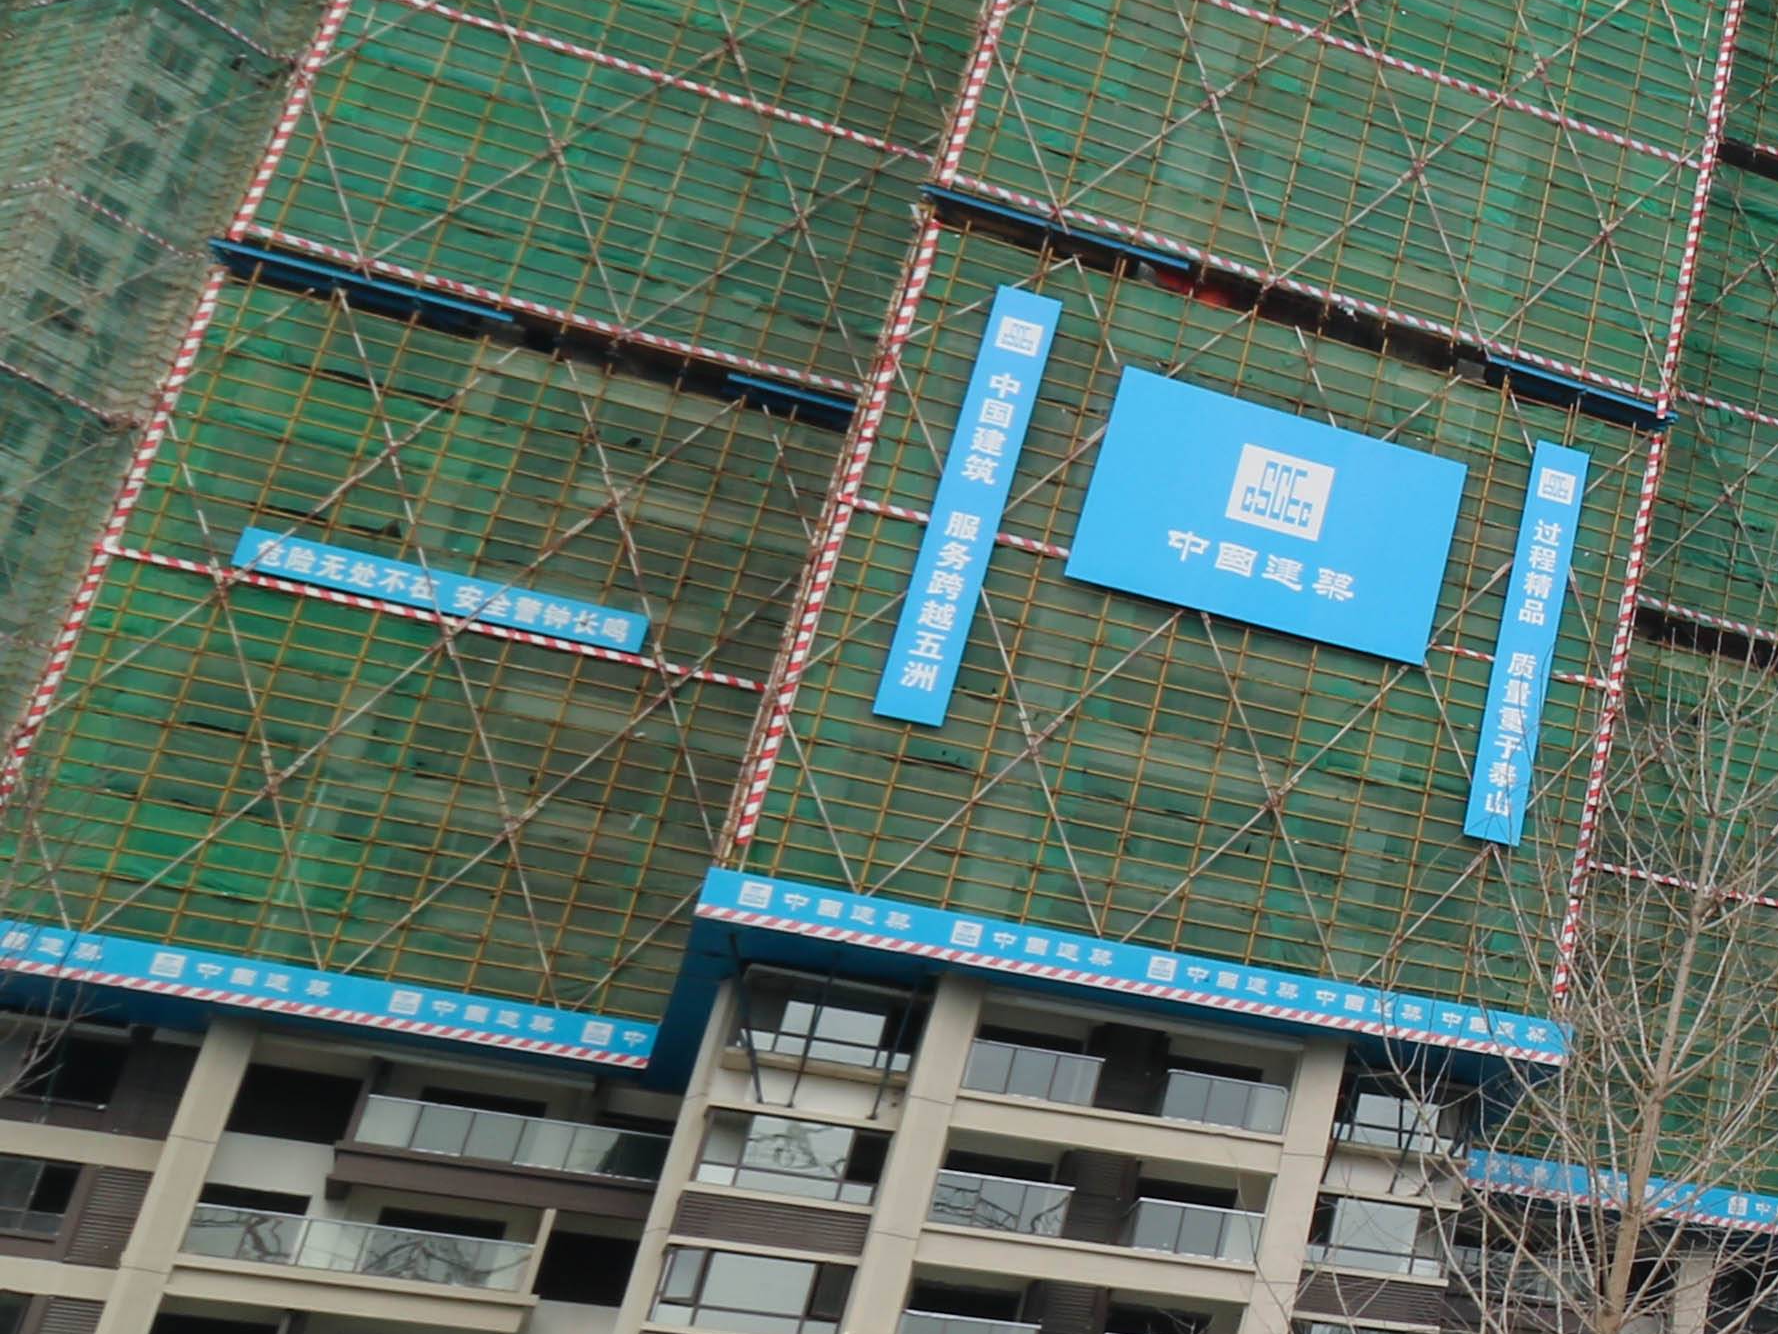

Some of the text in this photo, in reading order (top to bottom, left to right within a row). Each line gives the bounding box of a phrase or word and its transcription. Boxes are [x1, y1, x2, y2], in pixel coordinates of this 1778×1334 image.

[257, 538, 631, 644] 危险无处不在 安全警钟长鸣
[899, 372, 1022, 693] 中国建筑 服务跨越五洲
[1485, 519, 1562, 818] 过程精品 质量重于泰山
